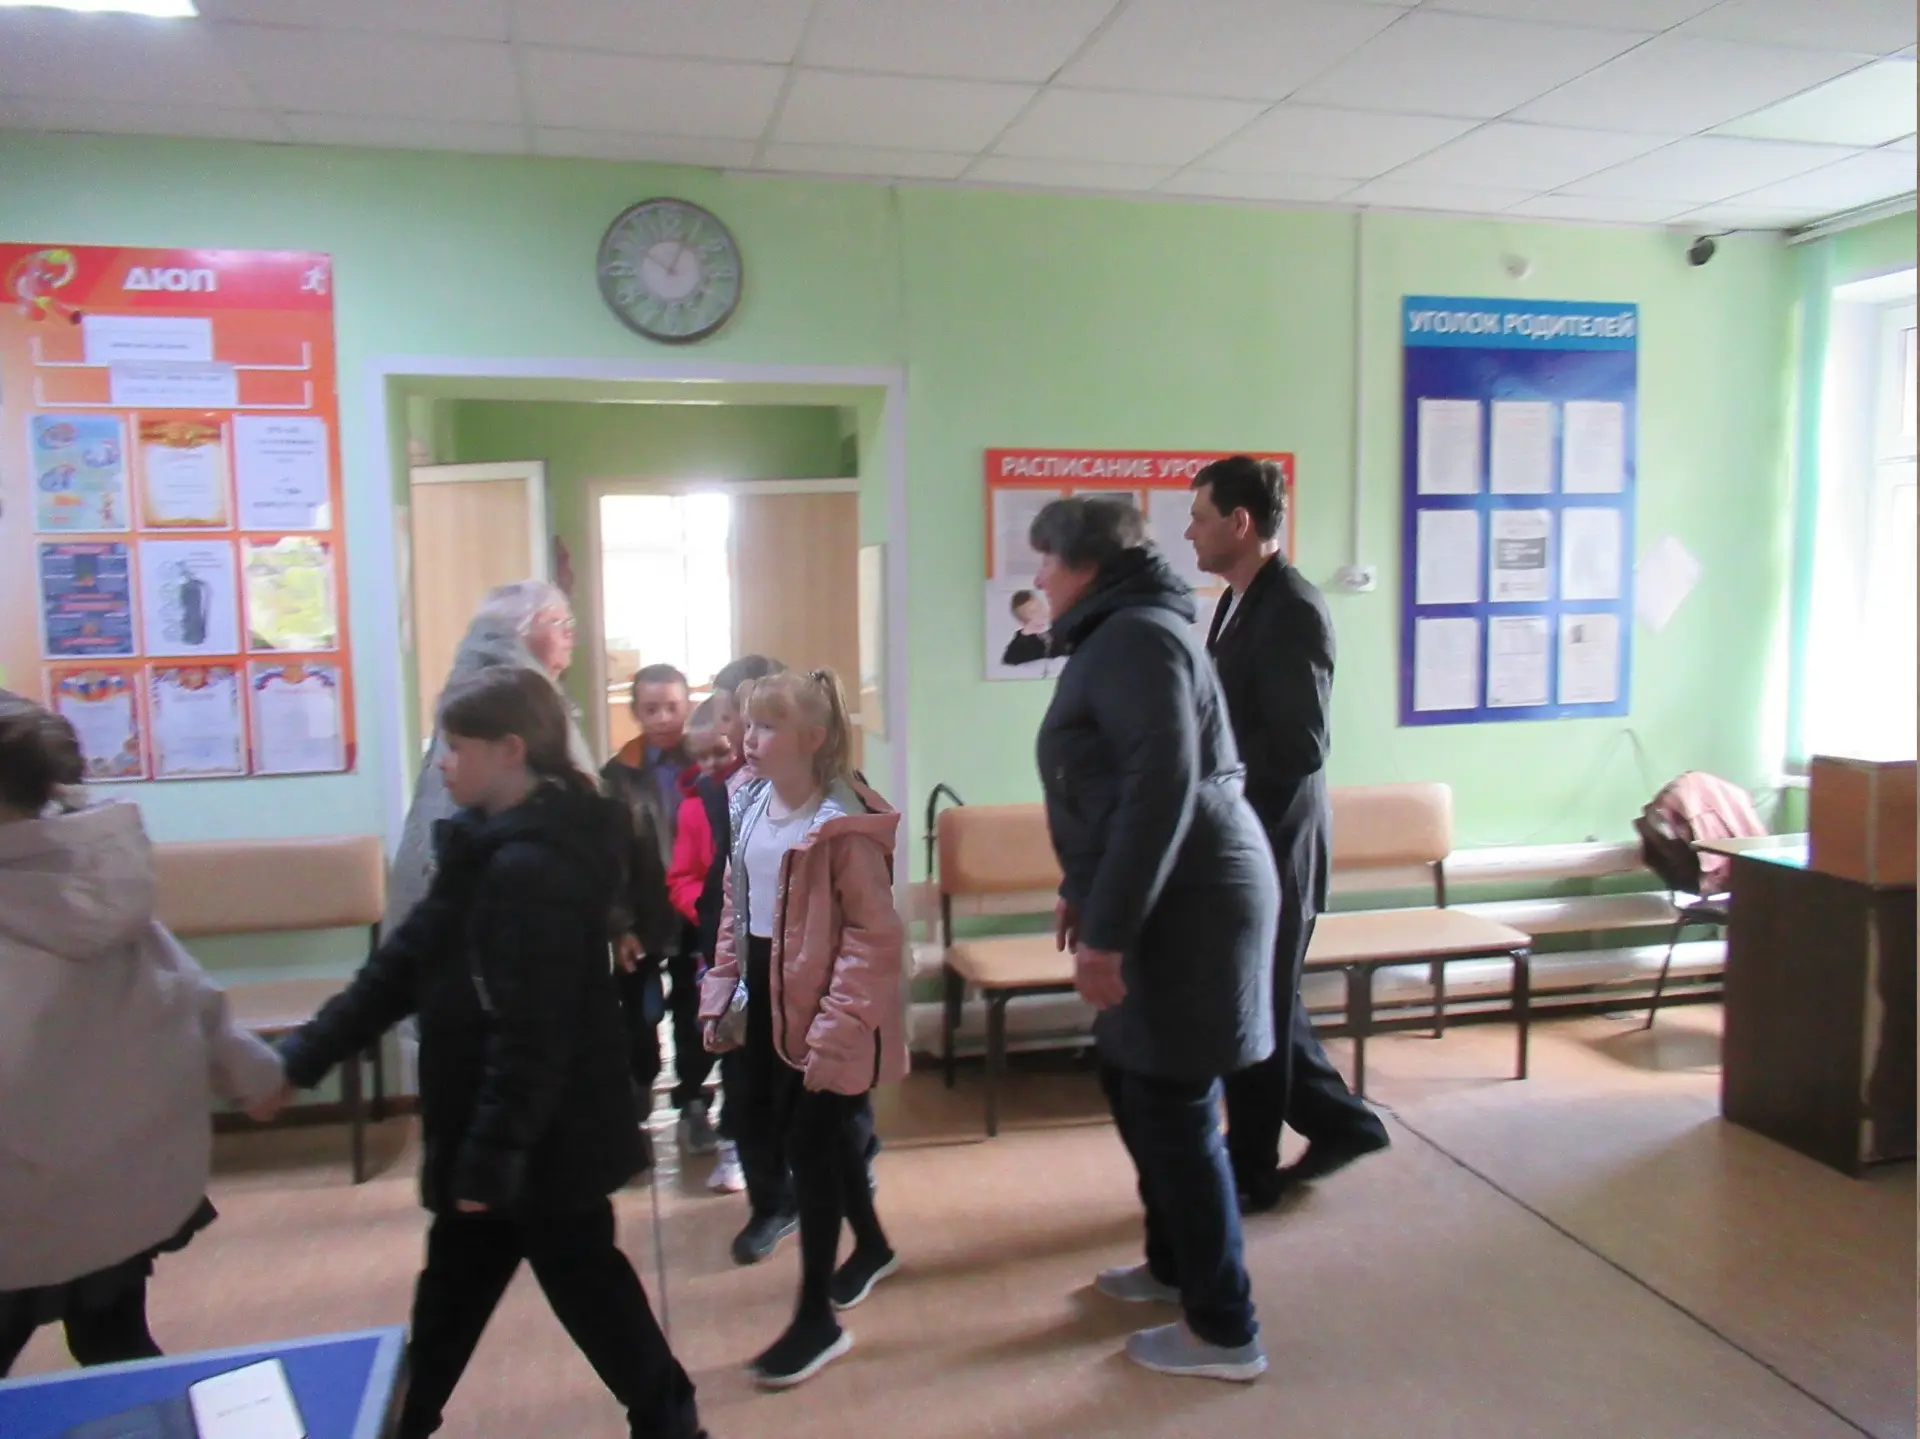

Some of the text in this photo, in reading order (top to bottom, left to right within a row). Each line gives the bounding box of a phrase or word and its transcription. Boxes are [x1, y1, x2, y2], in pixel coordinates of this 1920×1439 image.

[123, 266, 217, 292] ДЮП
[1408, 310, 1636, 341] УГОЛОК РОДИТЕЛЕЙ
[1001, 456, 1154, 479] РАСПИСАНИЕ
